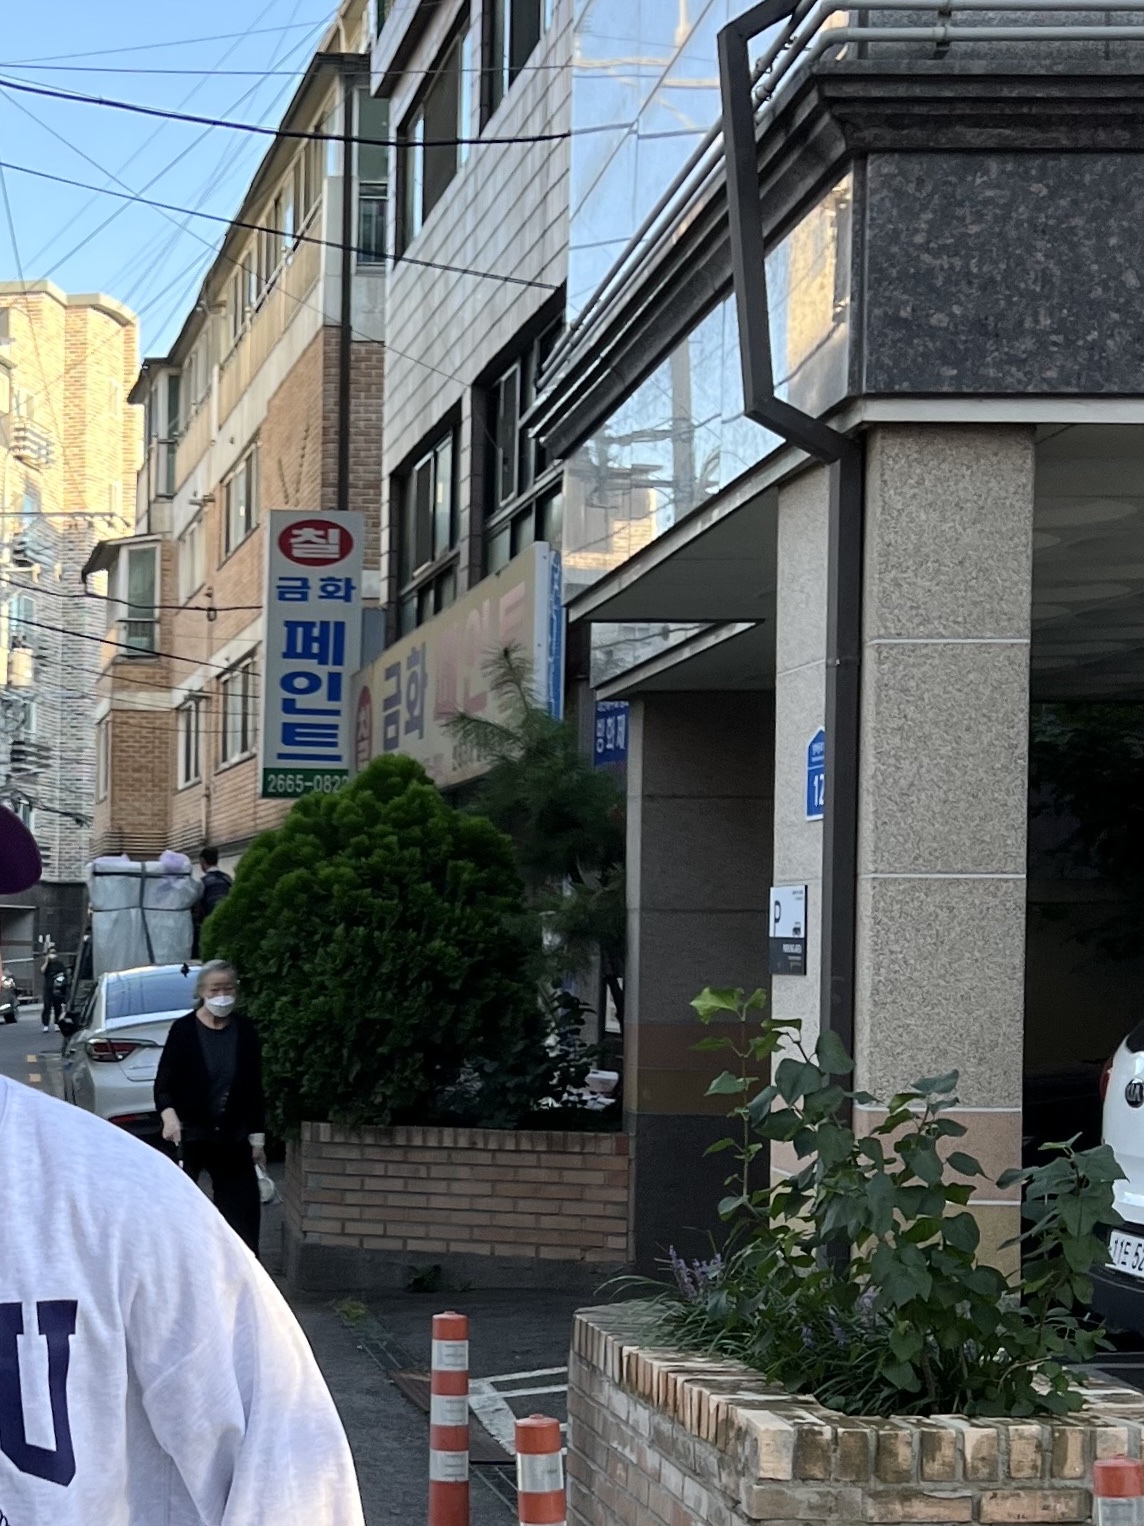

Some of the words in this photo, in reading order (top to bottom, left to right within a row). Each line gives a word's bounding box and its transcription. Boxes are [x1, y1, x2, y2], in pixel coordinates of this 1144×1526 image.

[290, 528, 341, 559] 칠
[276, 576, 356, 603] 금화
[277, 620, 346, 762] 페인트
[383, 641, 428, 752] 금화
